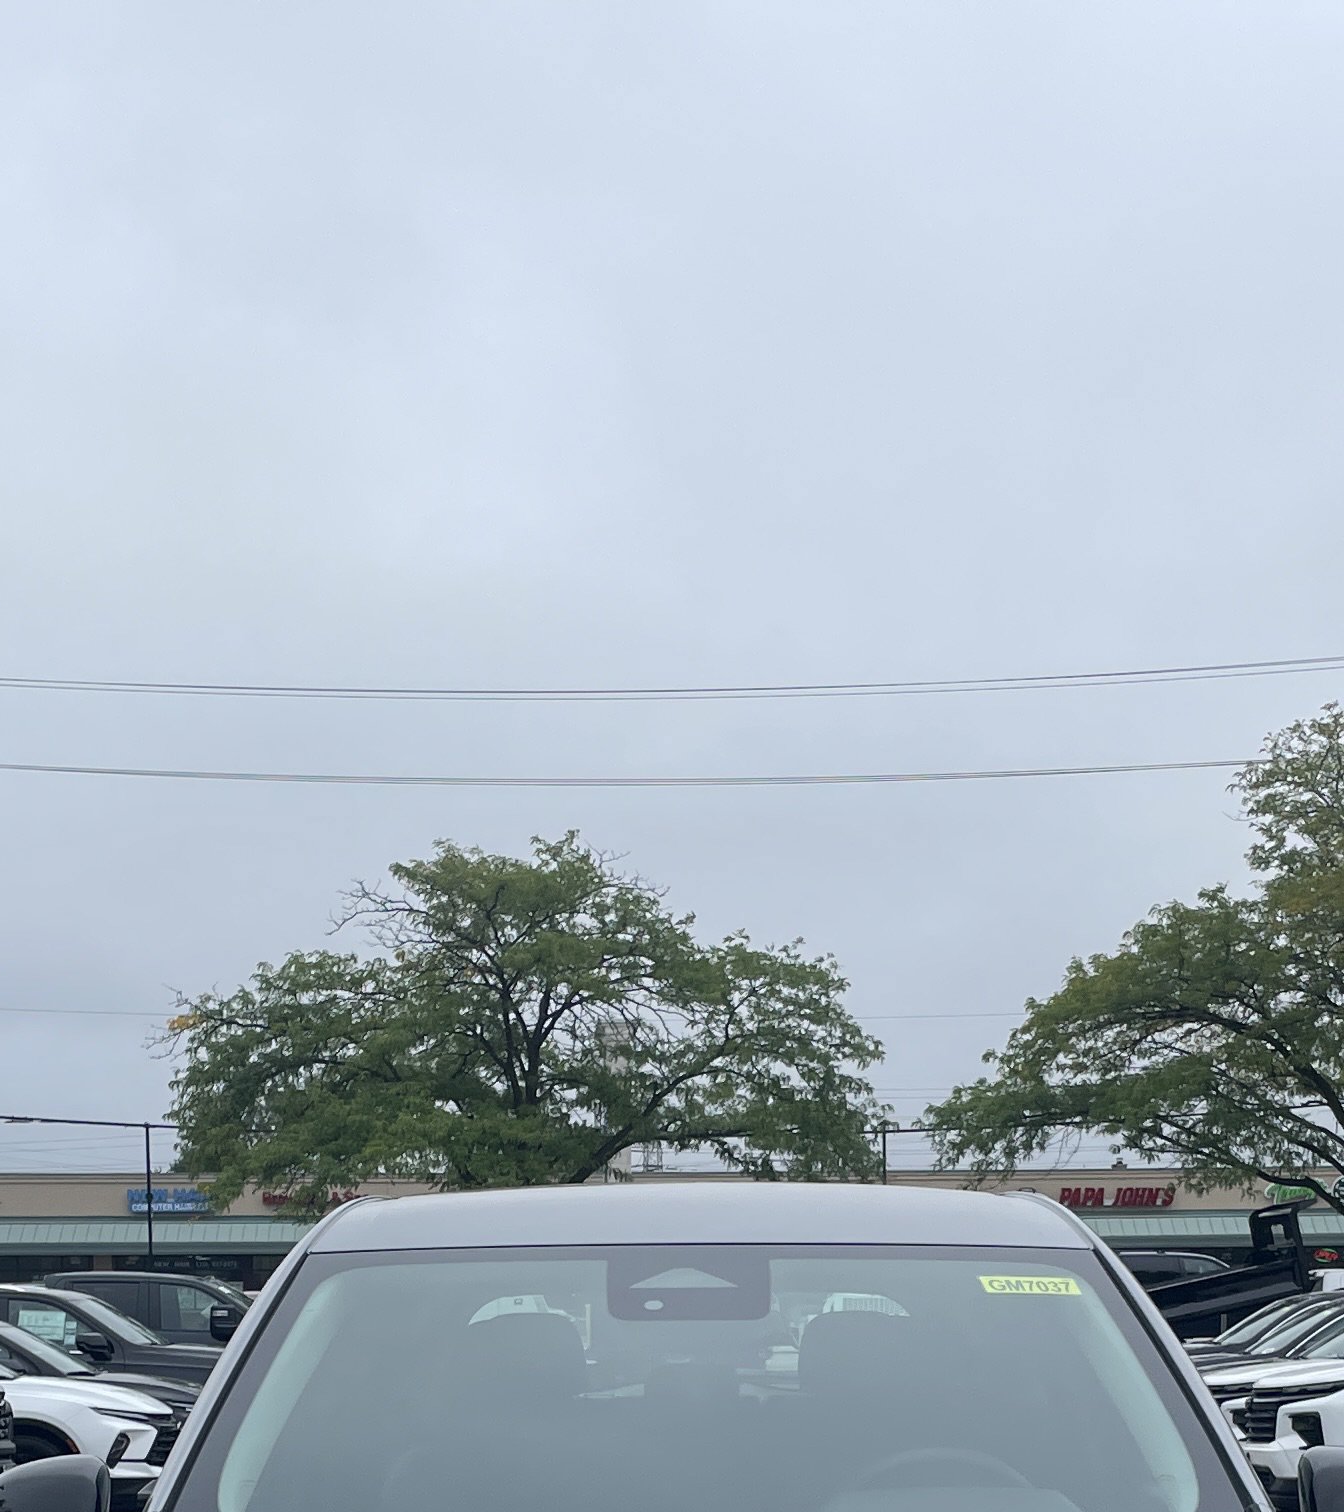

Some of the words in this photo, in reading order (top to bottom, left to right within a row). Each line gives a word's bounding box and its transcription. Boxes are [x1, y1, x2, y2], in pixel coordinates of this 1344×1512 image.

[1059, 1188, 1104, 1207] PAPA
[1112, 1187, 1175, 1207] JOHN'S
[131, 1203, 174, 1212] COMUTER
[988, 1279, 1070, 1293] GM7037
